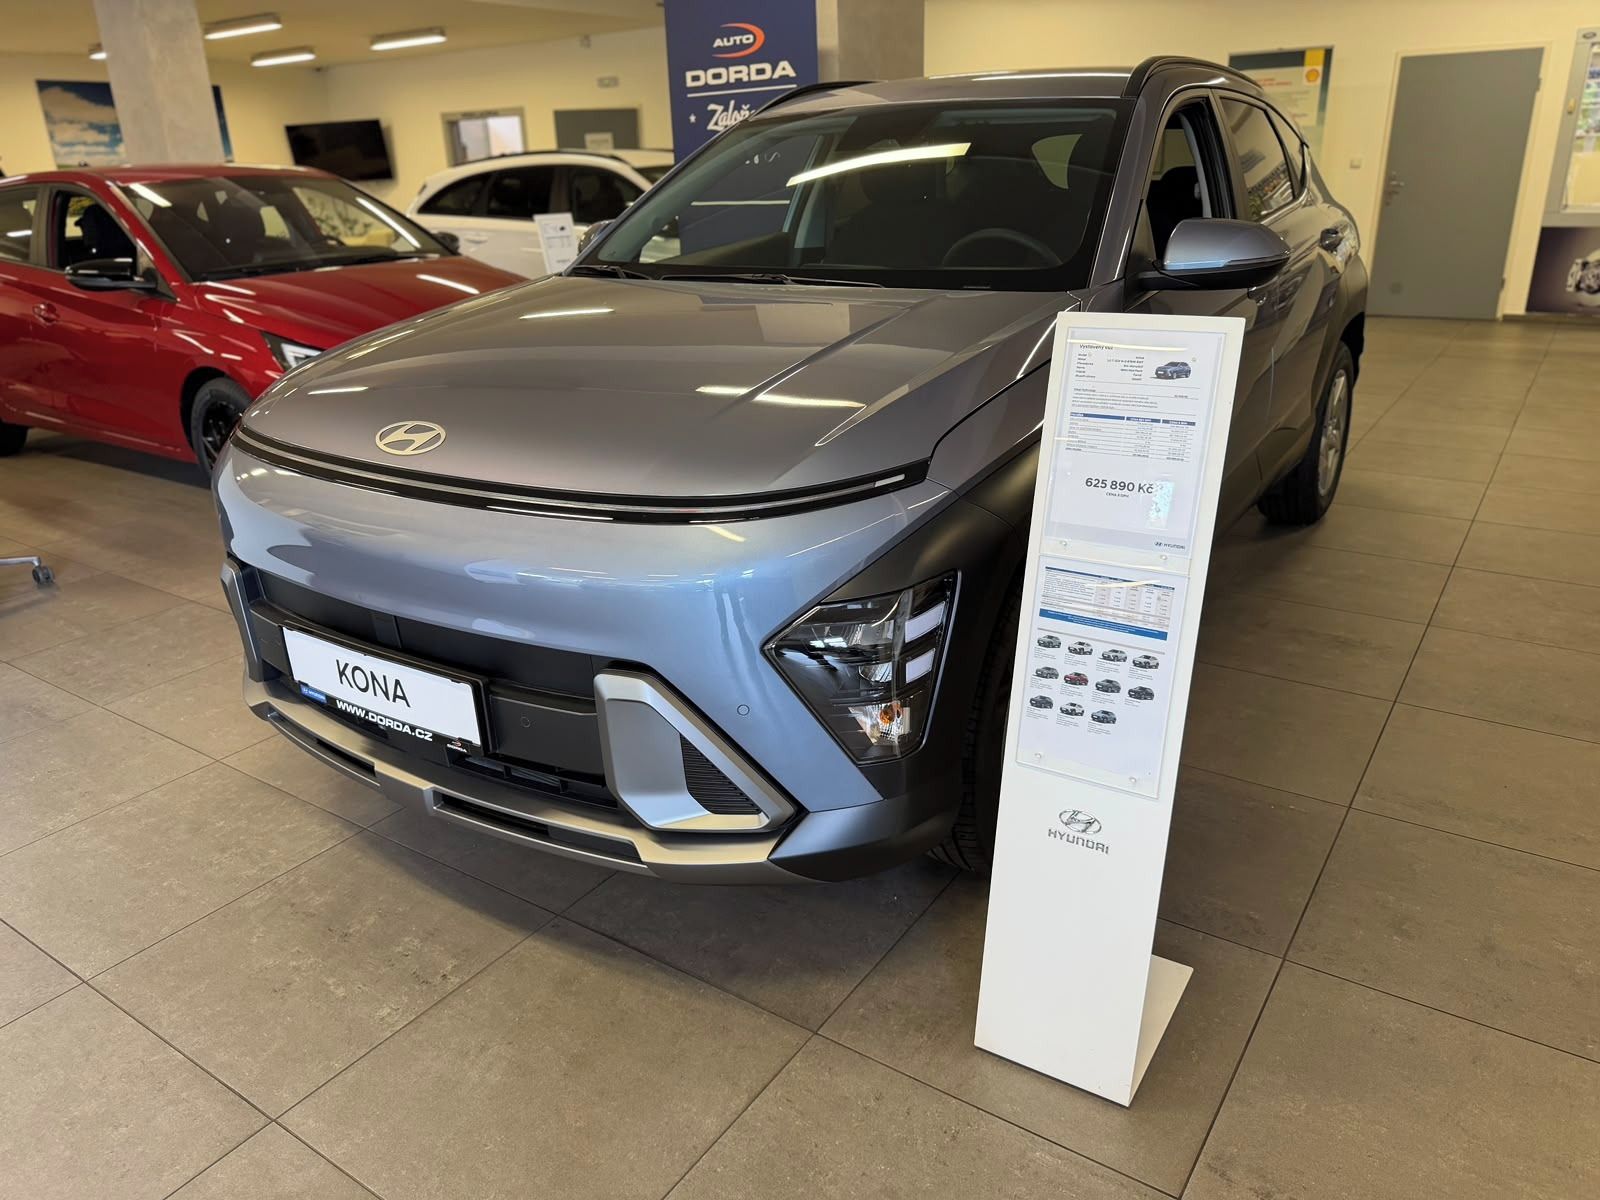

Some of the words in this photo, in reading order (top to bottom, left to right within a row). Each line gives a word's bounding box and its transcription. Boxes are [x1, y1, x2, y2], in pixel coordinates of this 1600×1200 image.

[713, 34, 754, 48] AUTO
[685, 60, 796, 88] DORDA
[1085, 477, 1108, 489] 625
[1110, 480, 1136, 493] 890
[1137, 483, 1155, 494] Kč
[336, 659, 411, 708] KONA
[336, 699, 433, 742] WWW.DORDA.CZ
[1047, 828, 1110, 855] HYUNDAI
